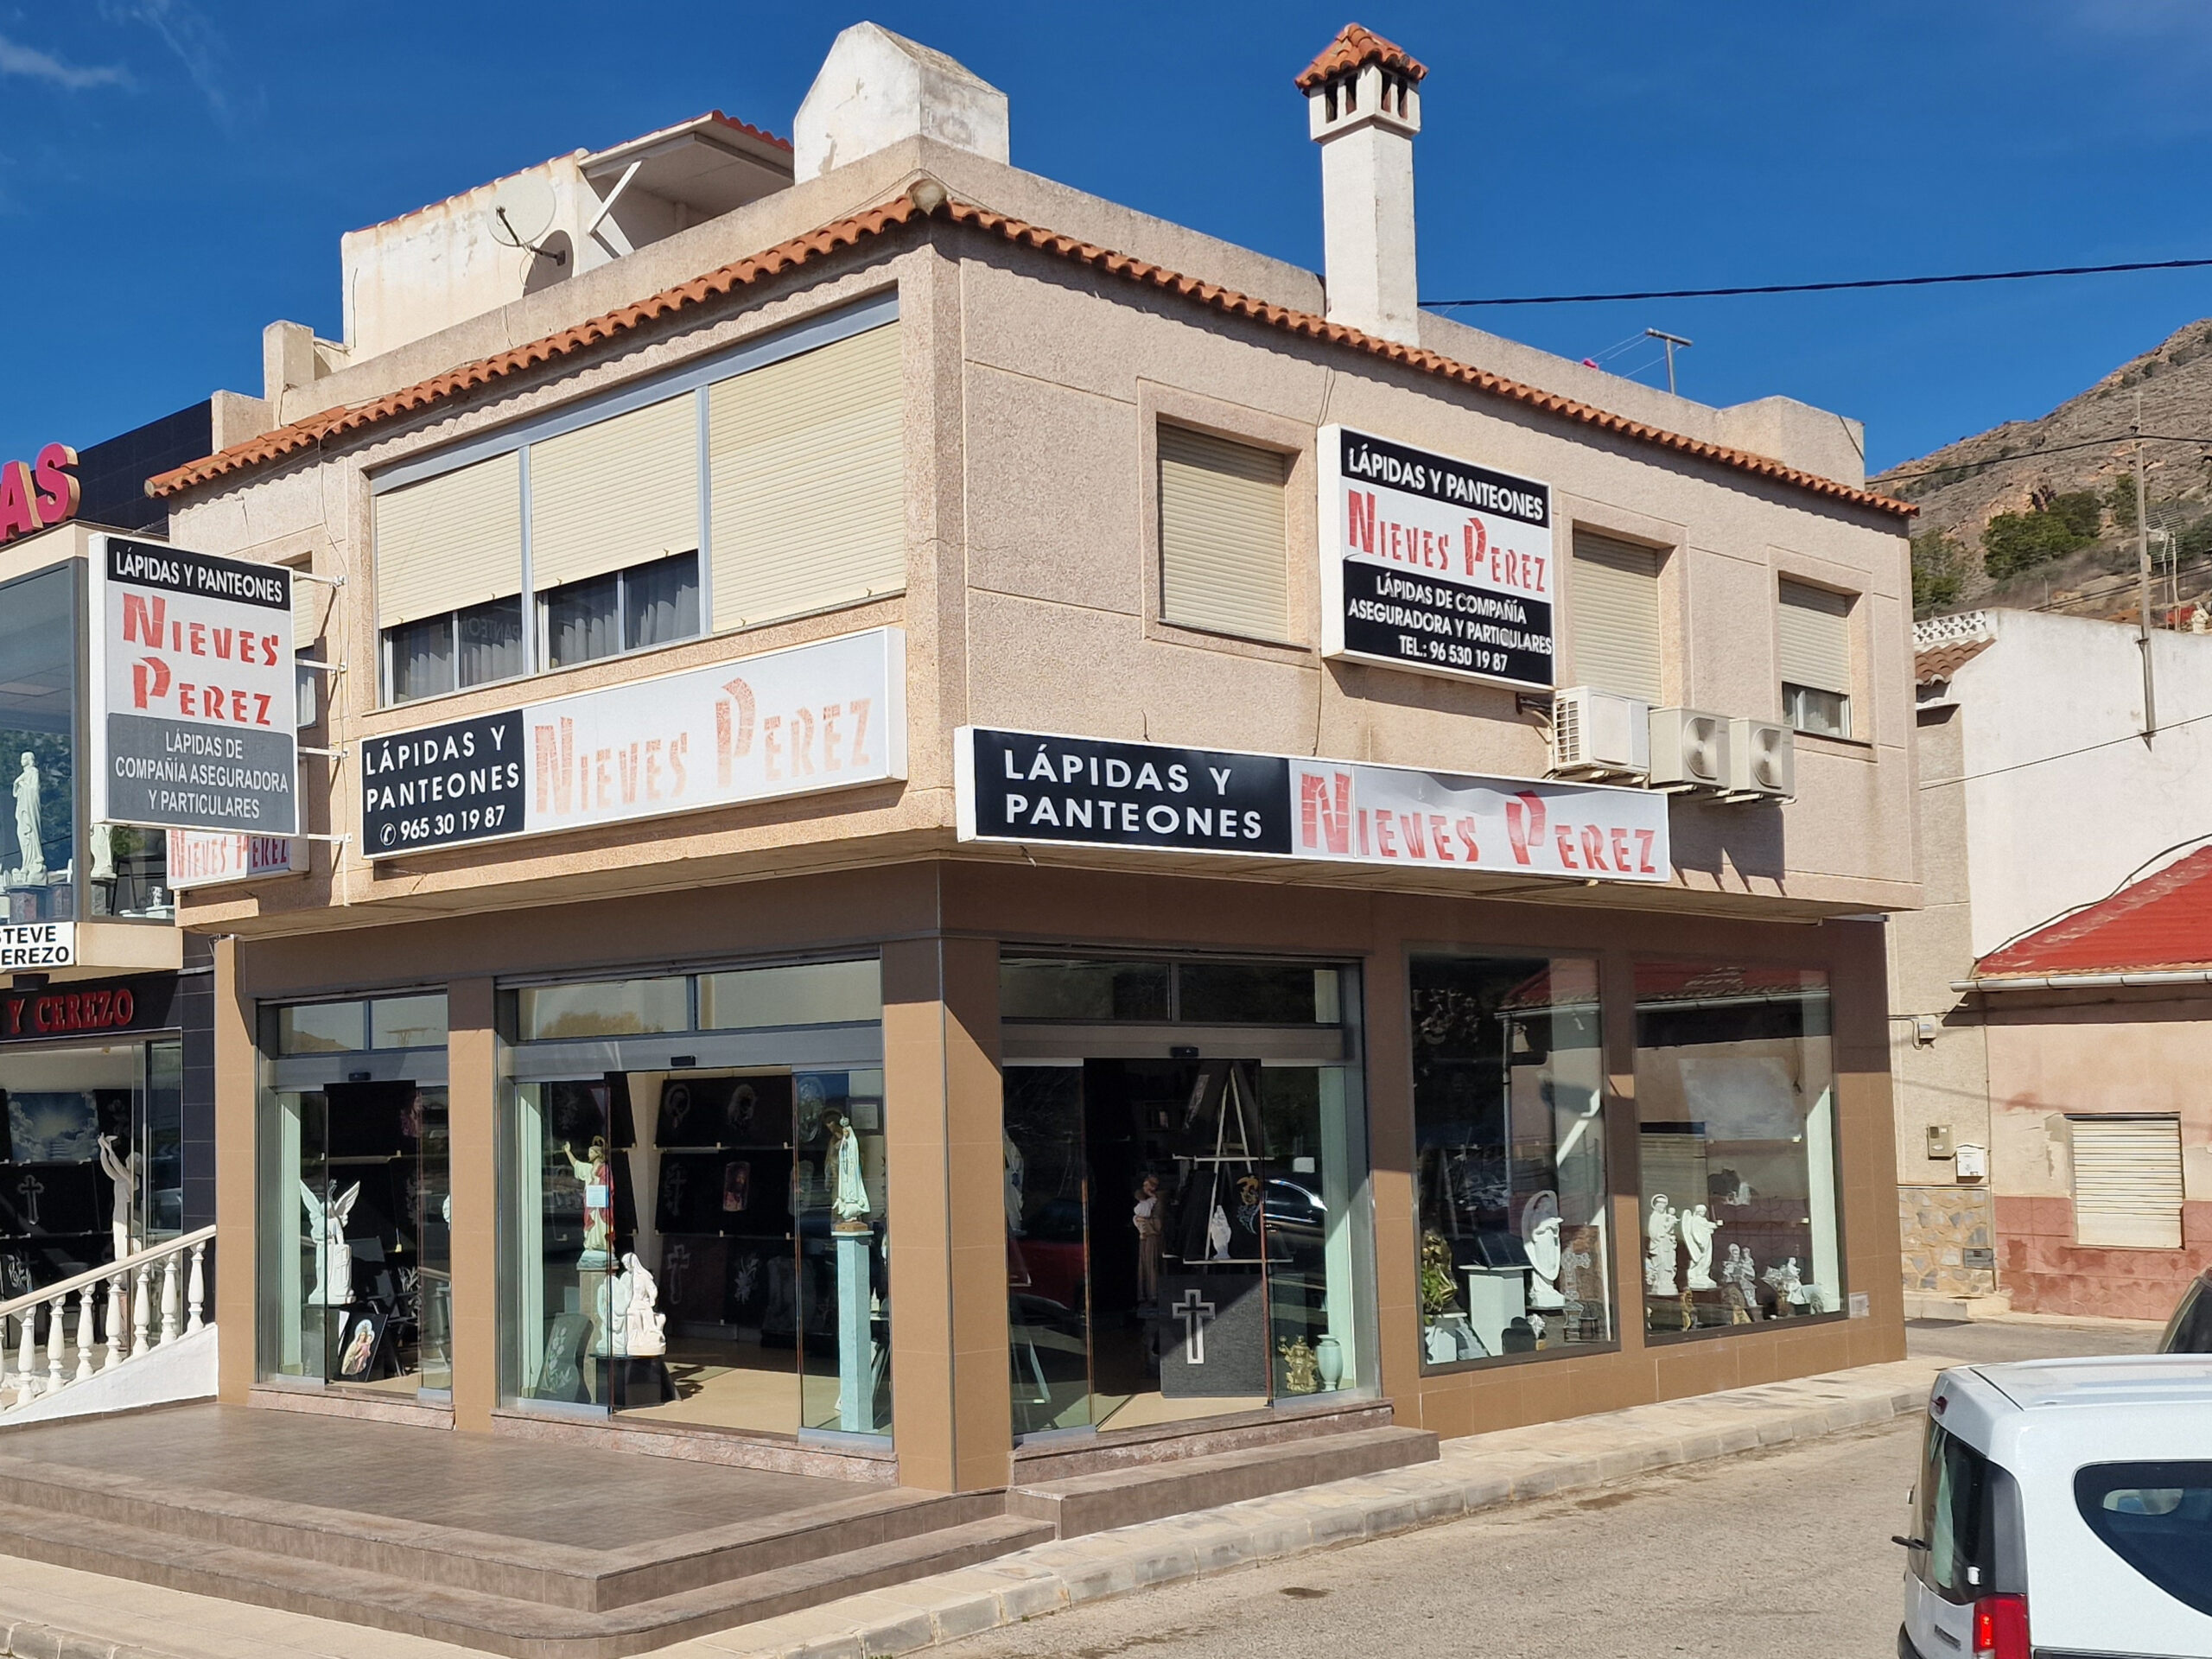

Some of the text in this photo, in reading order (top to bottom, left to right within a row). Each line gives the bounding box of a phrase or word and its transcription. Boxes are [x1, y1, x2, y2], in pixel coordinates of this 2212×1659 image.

[1348, 443, 1543, 520] LÁPIDAS Y PANTEONES
[1348, 489, 1545, 593] NIEVES PEREZ
[116, 547, 283, 603] LÁPIDAS Y PANTEONES
[1376, 572, 1528, 625] LÁPIDAS DE COMPAÑÍA
[123, 592, 279, 666] NIEVES
[1348, 598, 1553, 655] ASEGURADORA Y PARTICULARES
[1431, 640, 1446, 661] 96
[1448, 645, 1471, 665] 530
[1476, 649, 1491, 669] 19
[1492, 652, 1508, 672] 87
[131, 656, 271, 726] PEREZ
[166, 728, 244, 760] LÁPIDAS DE
[365, 725, 505, 775] LÁPIDAS Y
[535, 677, 872, 816] NIEVES PEREZ
[115, 756, 289, 793] COMPAÑÍA ASEGURADORA
[366, 762, 519, 812] PANTEONES
[1004, 744, 1231, 796] LÁPIDAS Y
[148, 790, 260, 819] Y PARTICULARES
[400, 804, 505, 841] 965 30 19 87
[1006, 793, 1262, 840] PANTEONES
[1301, 771, 1656, 873] NIEVES PEREZ
[170, 830, 226, 878] NIEVES
[0, 925, 56, 944] TEVE
[7, 988, 134, 1034] Y CEREZO
